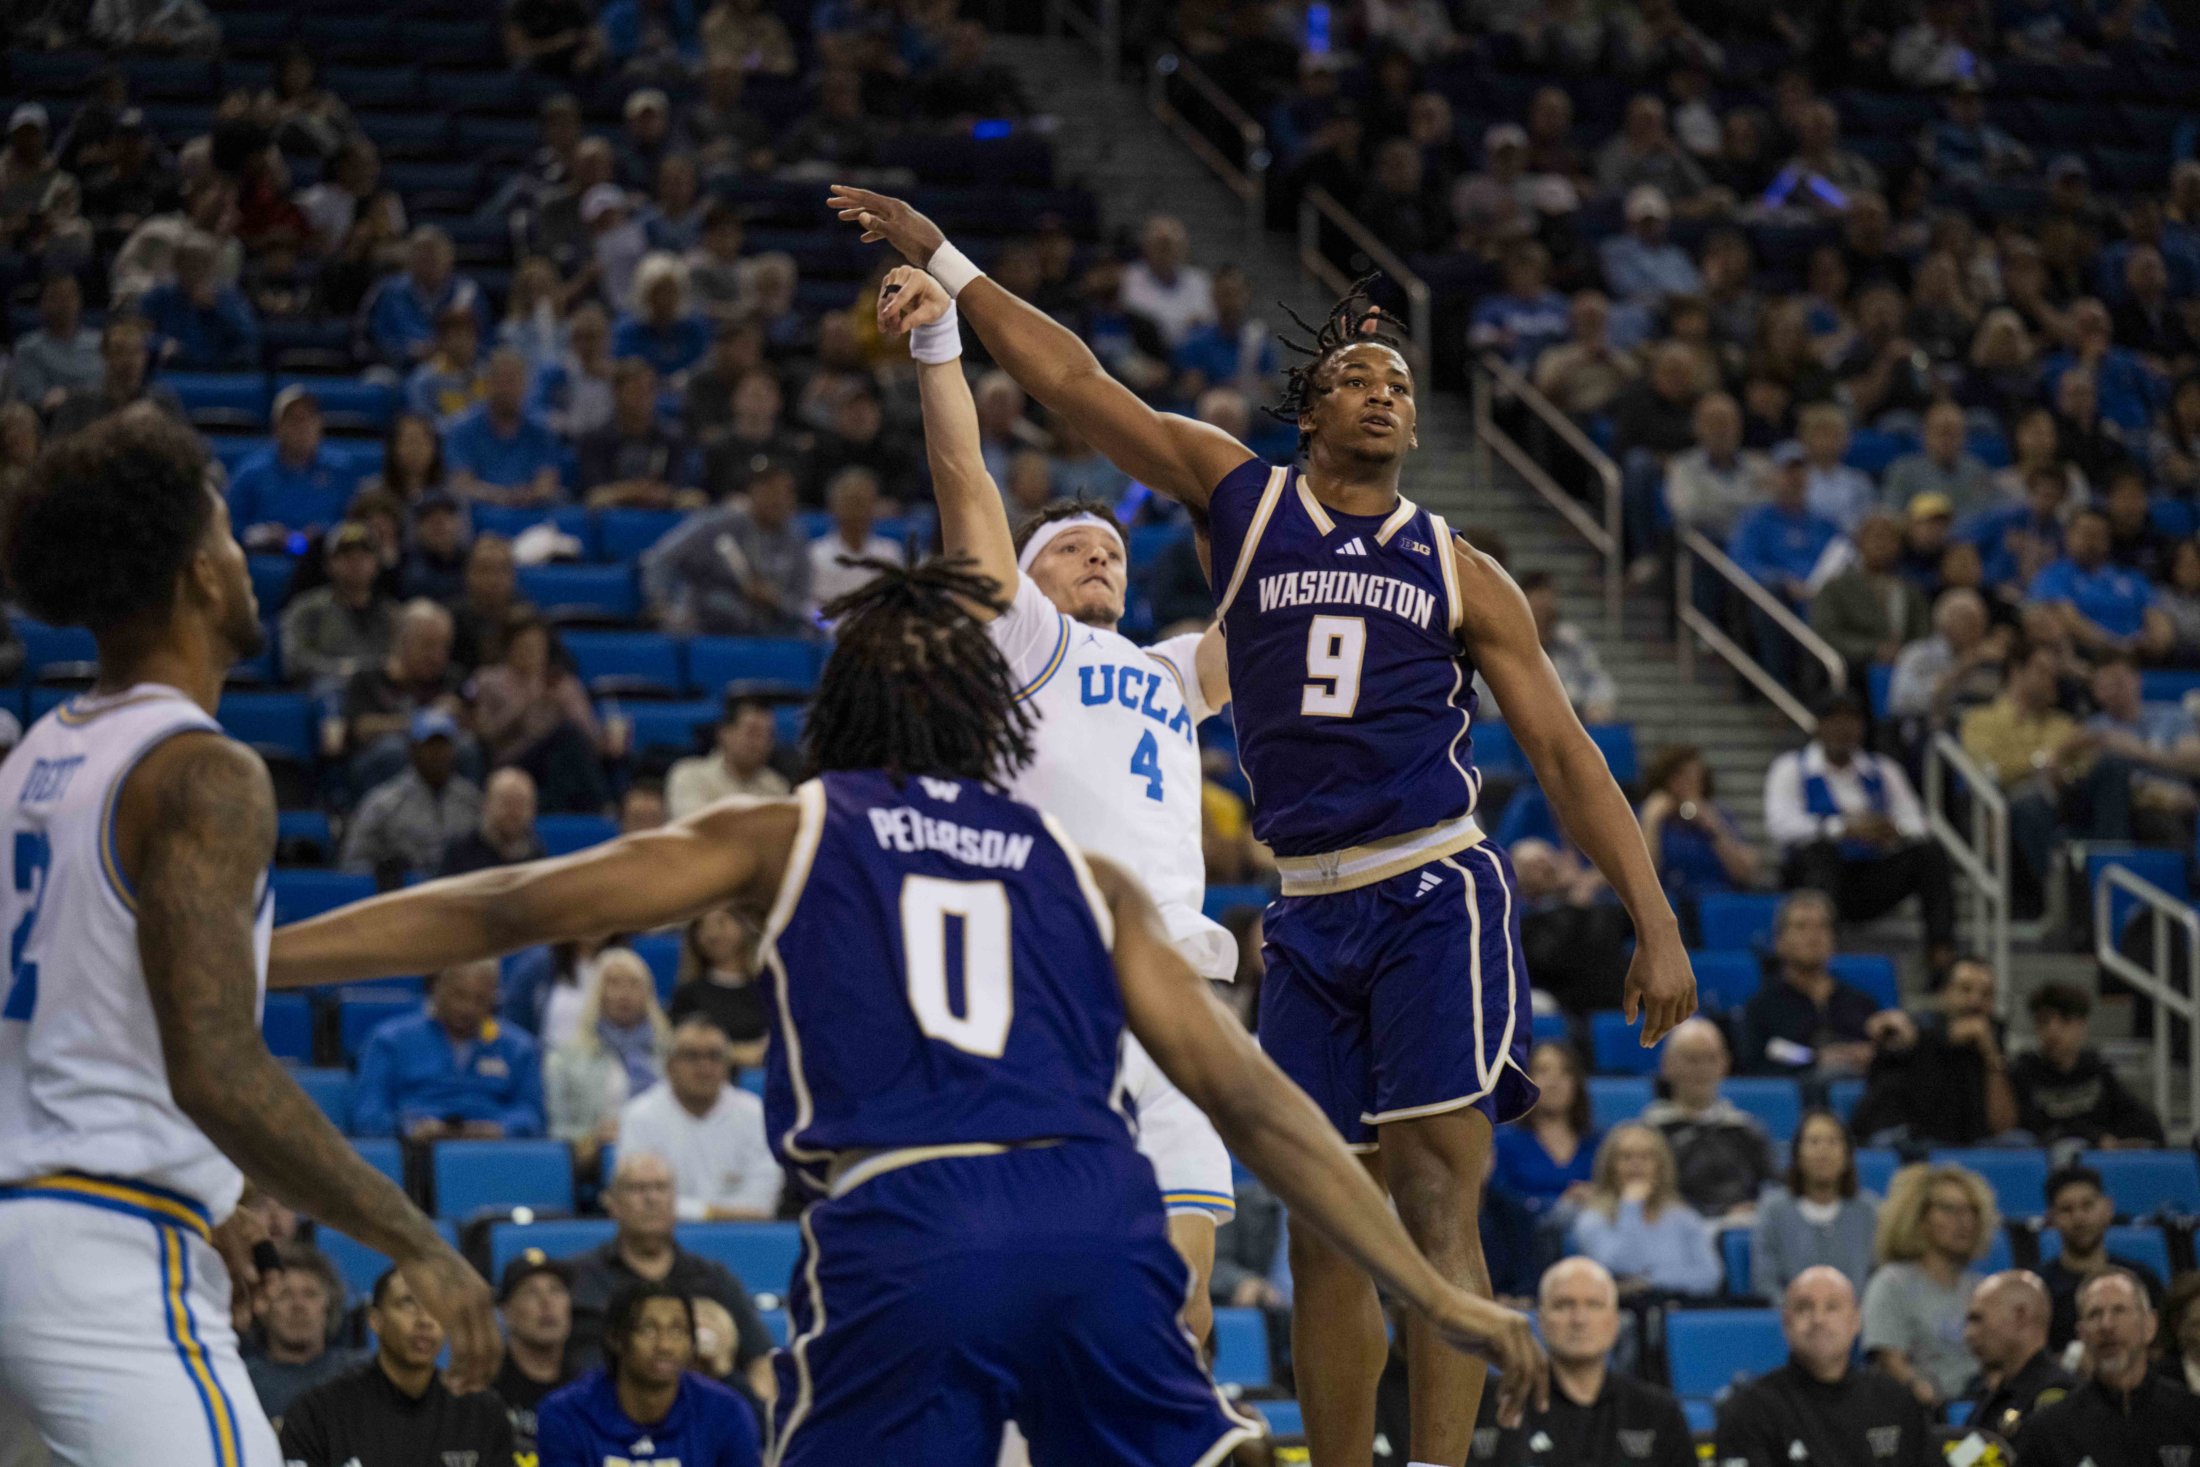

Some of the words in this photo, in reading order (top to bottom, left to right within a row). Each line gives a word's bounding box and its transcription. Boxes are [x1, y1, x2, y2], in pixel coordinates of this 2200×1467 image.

[1259, 570, 1436, 631] WASHINGTON
[1079, 664, 1193, 746] UCLA
[1301, 614, 1367, 718] 9
[1131, 728, 1164, 803] 4
[3, 830, 51, 1021] 2
[899, 872, 1014, 1059] 0
